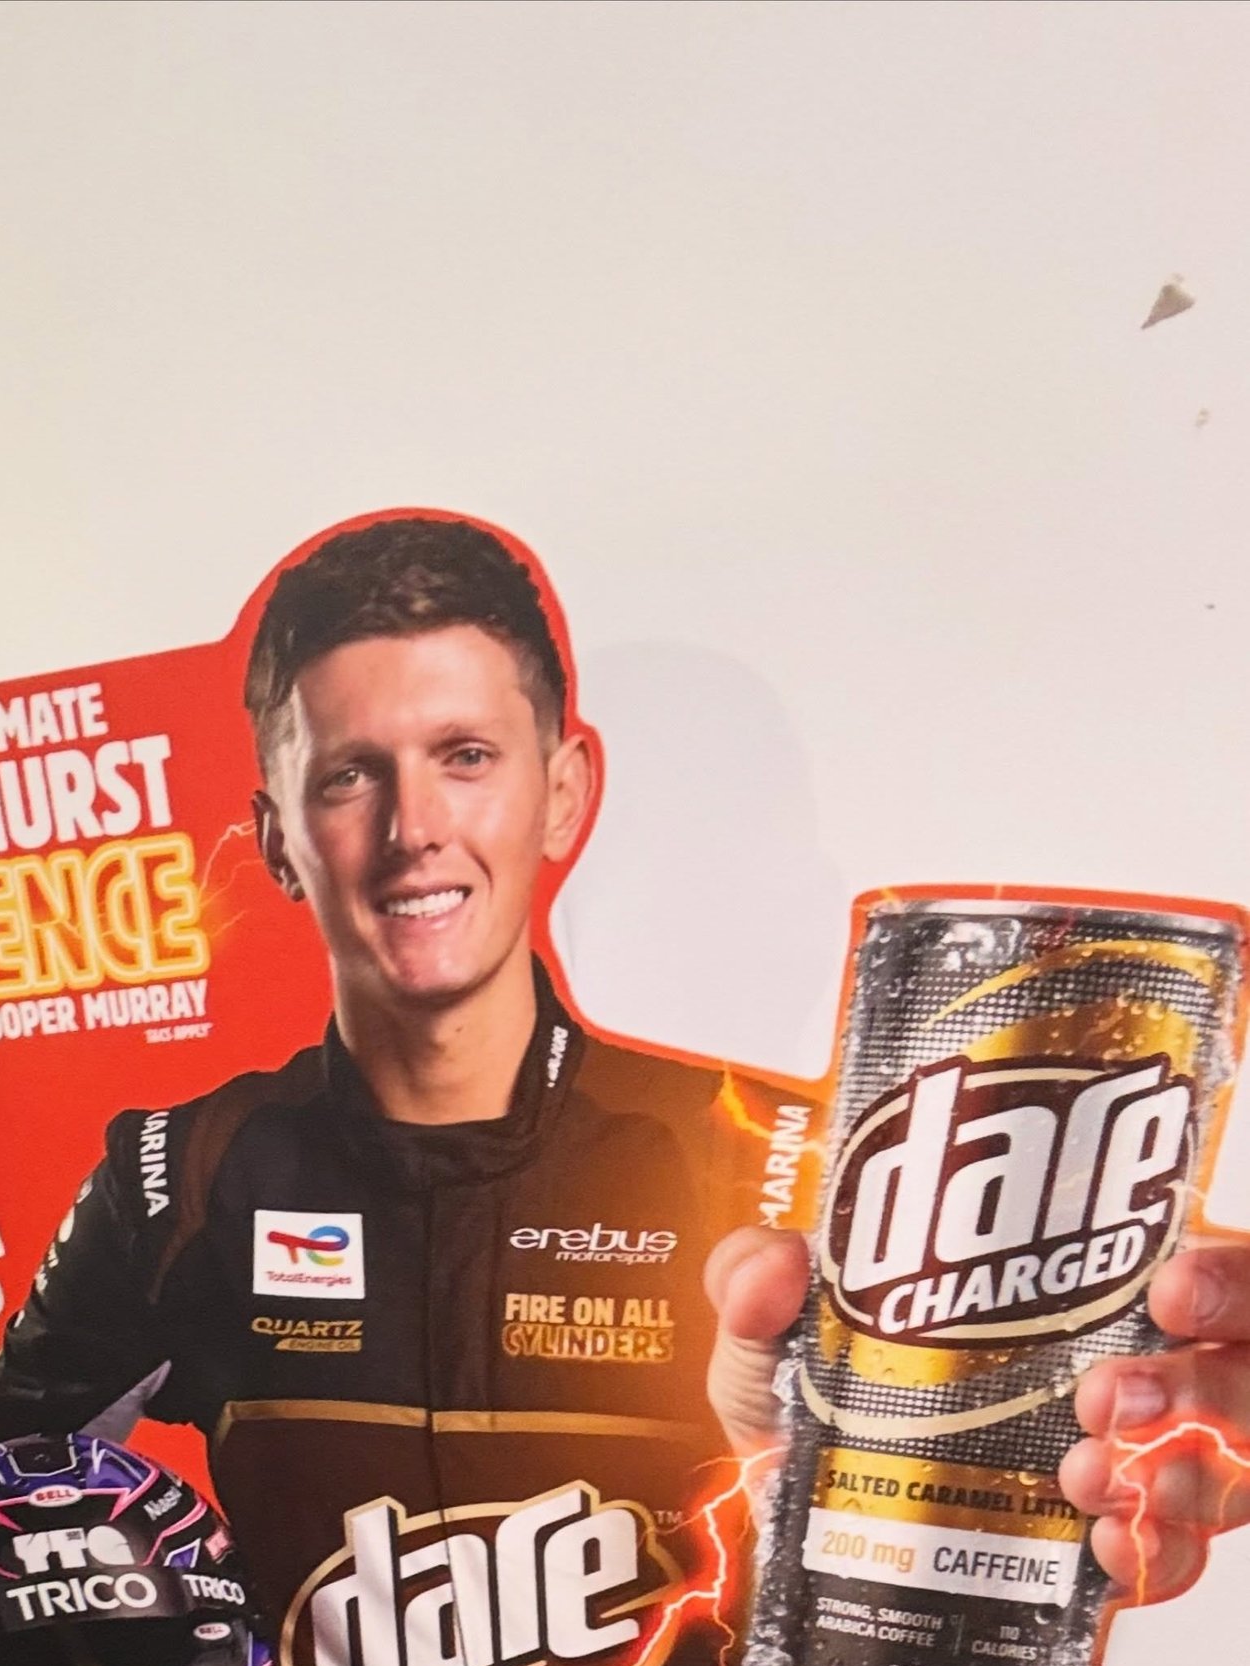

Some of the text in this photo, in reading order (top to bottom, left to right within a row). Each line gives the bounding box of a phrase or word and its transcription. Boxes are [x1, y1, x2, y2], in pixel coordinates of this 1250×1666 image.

[83, 979, 209, 1028] MURRAY
[840, 1064, 1192, 1294] dare
[508, 1221, 678, 1253] erebus
[554, 1248, 673, 1267] motorsport
[265, 1270, 353, 1288] TotalEnergies
[874, 1222, 1150, 1339] CHARGED
[251, 1316, 365, 1338] QUARTZ
[504, 1294, 675, 1329] FIRE ON ALL
[501, 1324, 675, 1364] CYLINDERS
[35, 1487, 76, 1503] BELL
[826, 1469, 900, 1499] SALTED
[905, 1482, 1015, 1513] CARAMEL
[655, 1509, 685, 1525] TM
[821, 1530, 1061, 1586] 200 mg CAFFEINE
[5, 1572, 158, 1624] TRICO
[182, 1573, 246, 1606] TRICO
[816, 1597, 944, 1630] STRONG, SMOOTH
[815, 1615, 937, 1648] ARABICA COFFEE
[970, 1639, 1038, 1661] CALORIES
